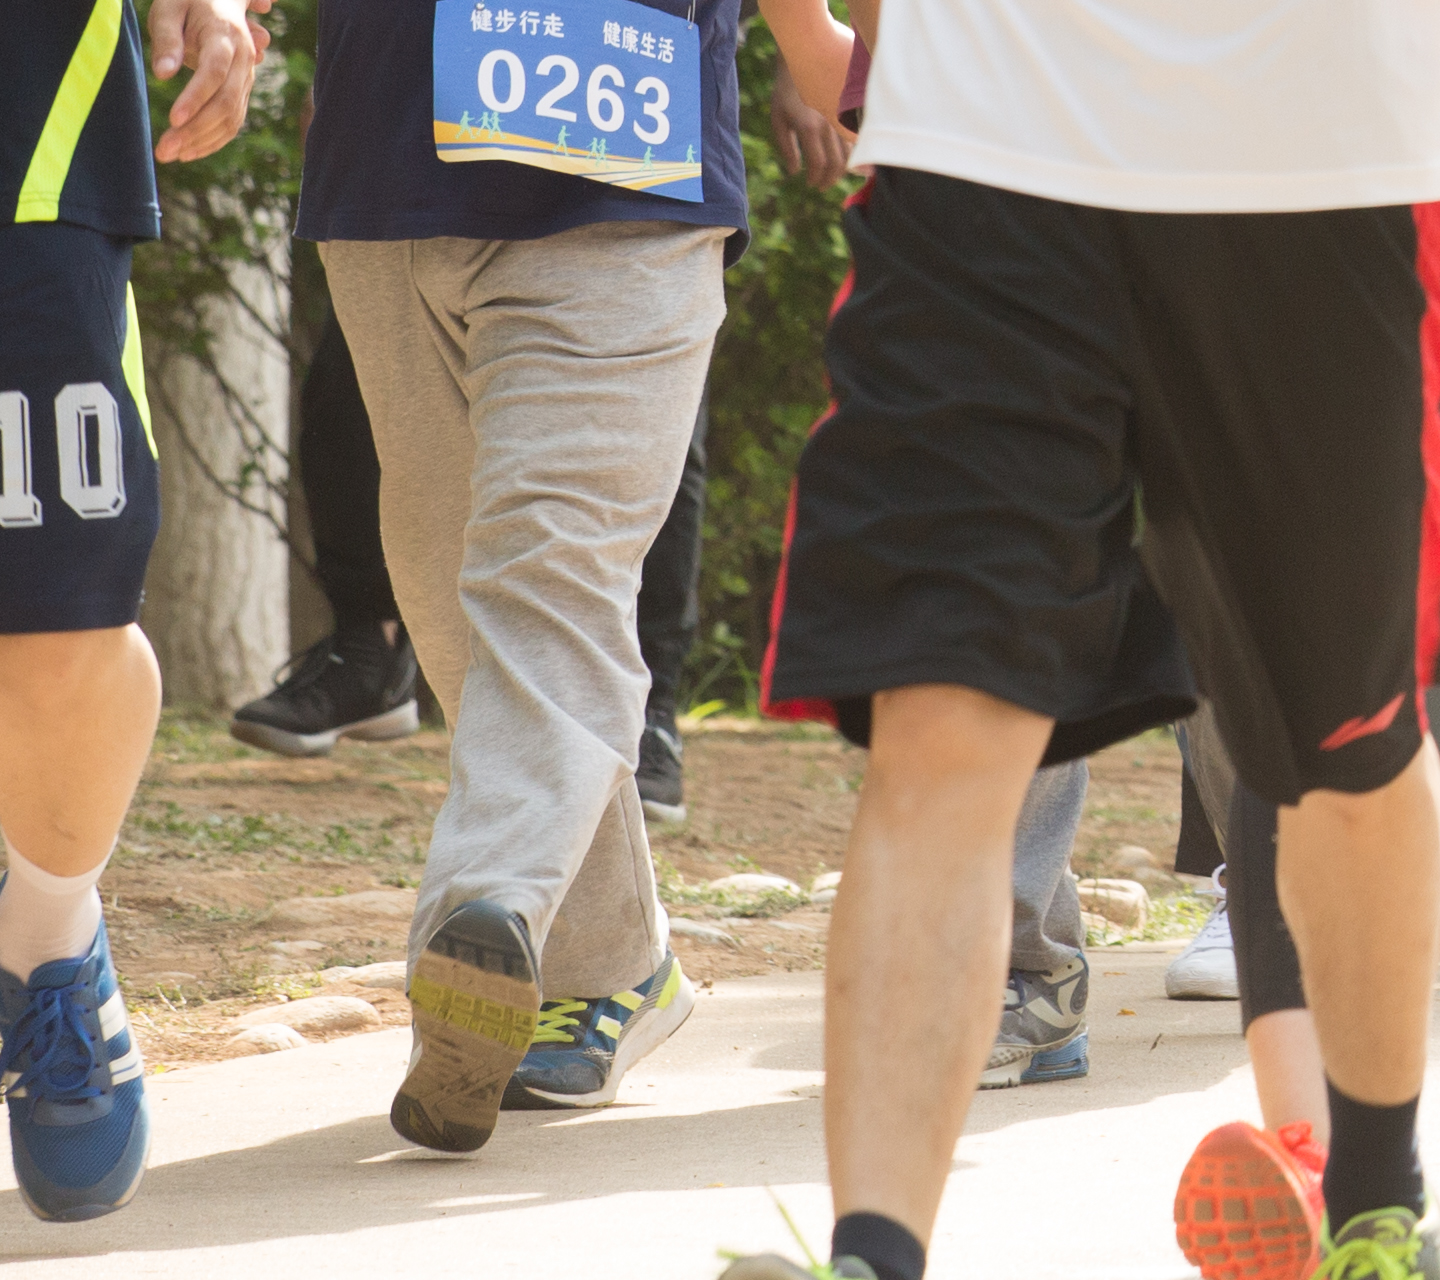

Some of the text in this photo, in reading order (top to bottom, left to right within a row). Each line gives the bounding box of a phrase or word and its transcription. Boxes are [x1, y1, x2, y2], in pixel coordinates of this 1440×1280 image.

[469, 8, 675, 64] 健步行走 健康生活
[477, 49, 671, 145] 0263
[0, 381, 127, 528] 10
